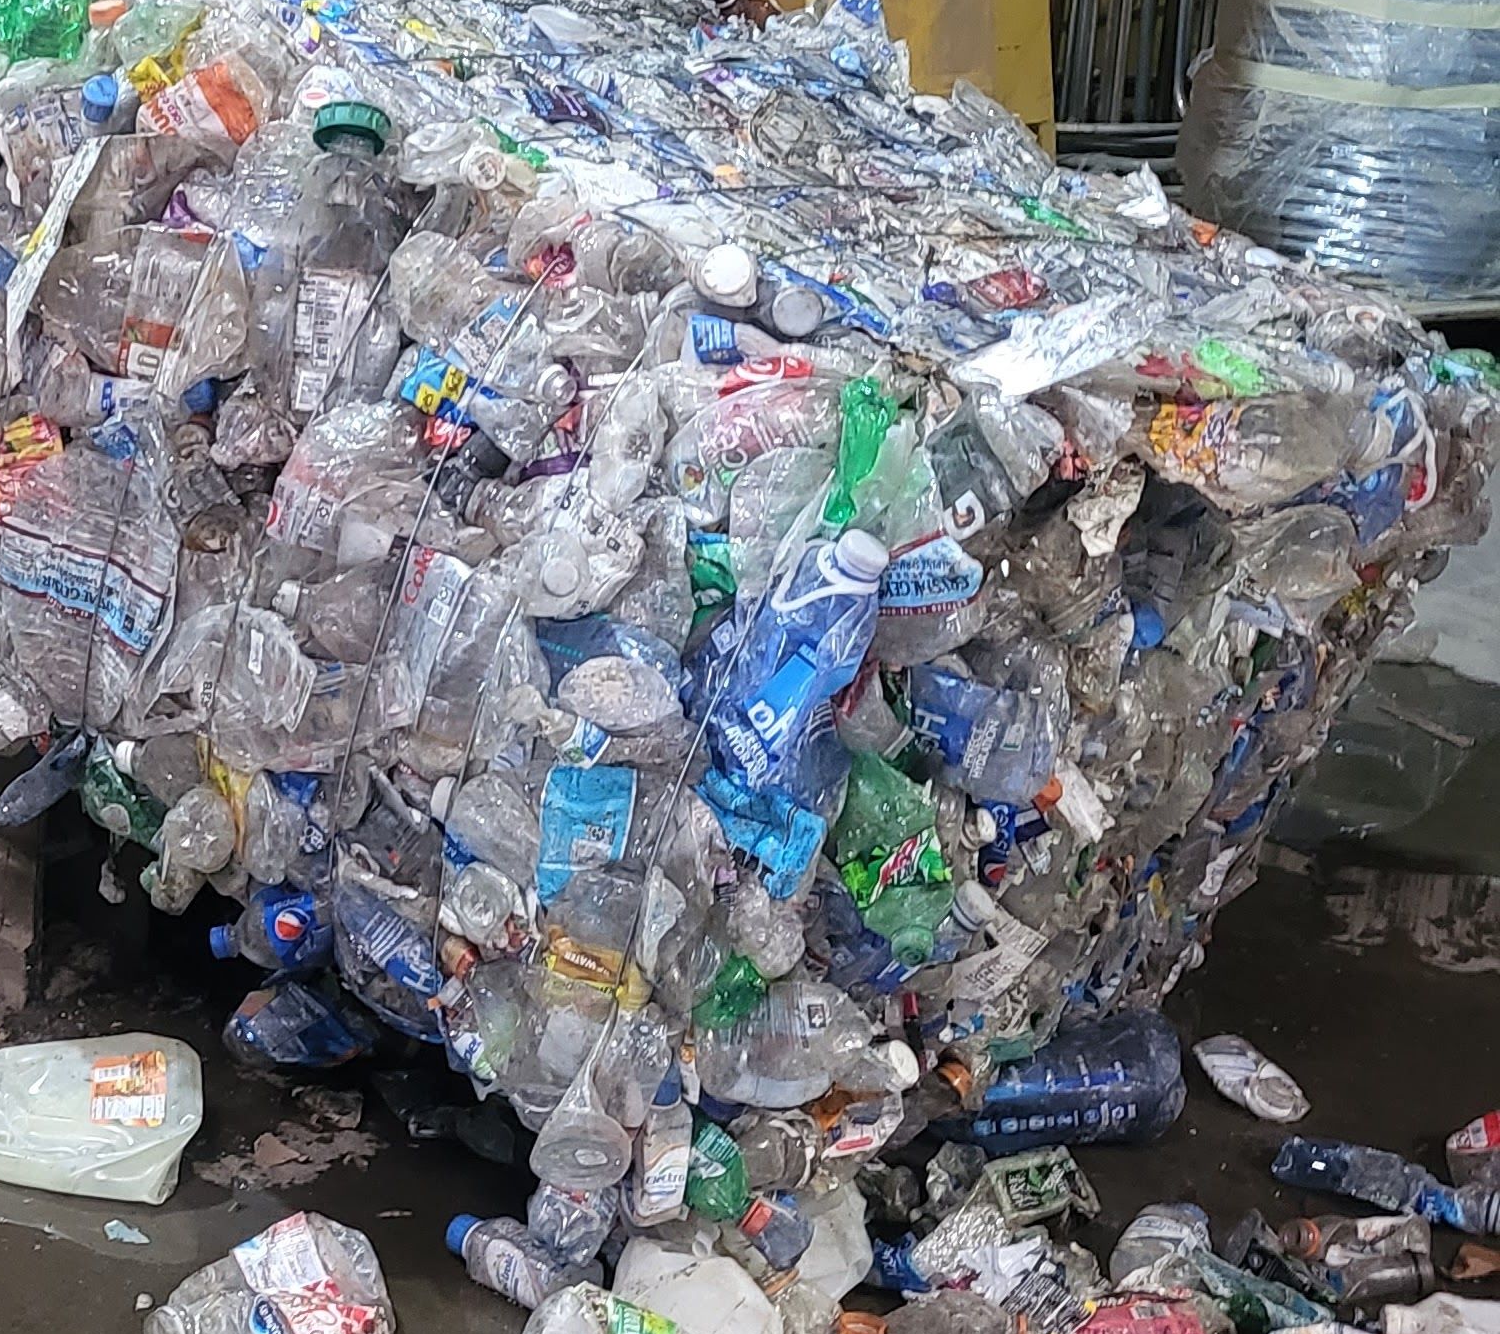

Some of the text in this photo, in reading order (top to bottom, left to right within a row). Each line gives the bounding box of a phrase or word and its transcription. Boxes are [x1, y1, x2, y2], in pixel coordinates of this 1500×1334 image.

[404, 547, 435, 604] Coke
[273, 896, 305, 912] pepsi
[564, 950, 597, 971] WATER
